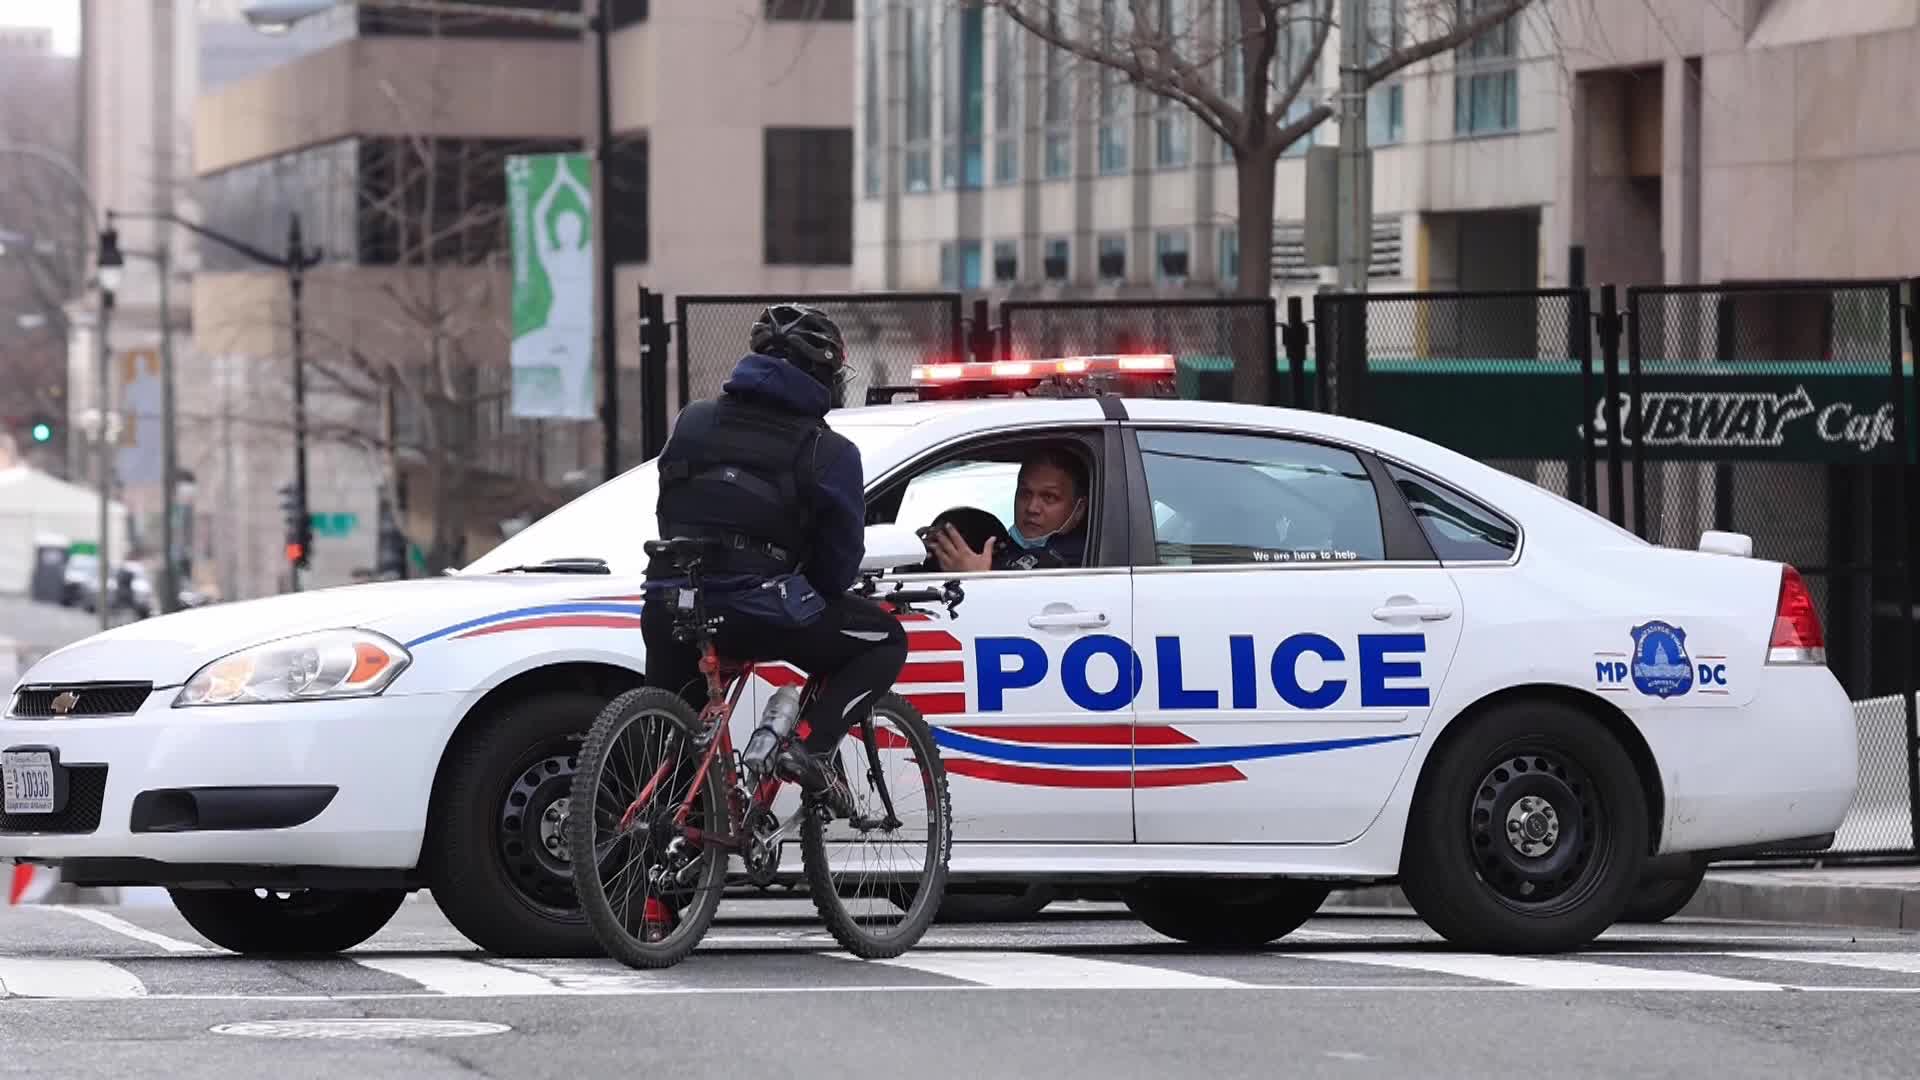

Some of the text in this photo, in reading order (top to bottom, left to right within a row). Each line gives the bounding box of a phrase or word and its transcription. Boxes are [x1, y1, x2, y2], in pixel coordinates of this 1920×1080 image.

[1253, 550, 1357, 561] We are here to help
[974, 632, 1431, 713] POLICE
[1595, 661, 1628, 683] MP
[1697, 663, 1728, 685] DC
[21, 769, 50, 798] 10336
